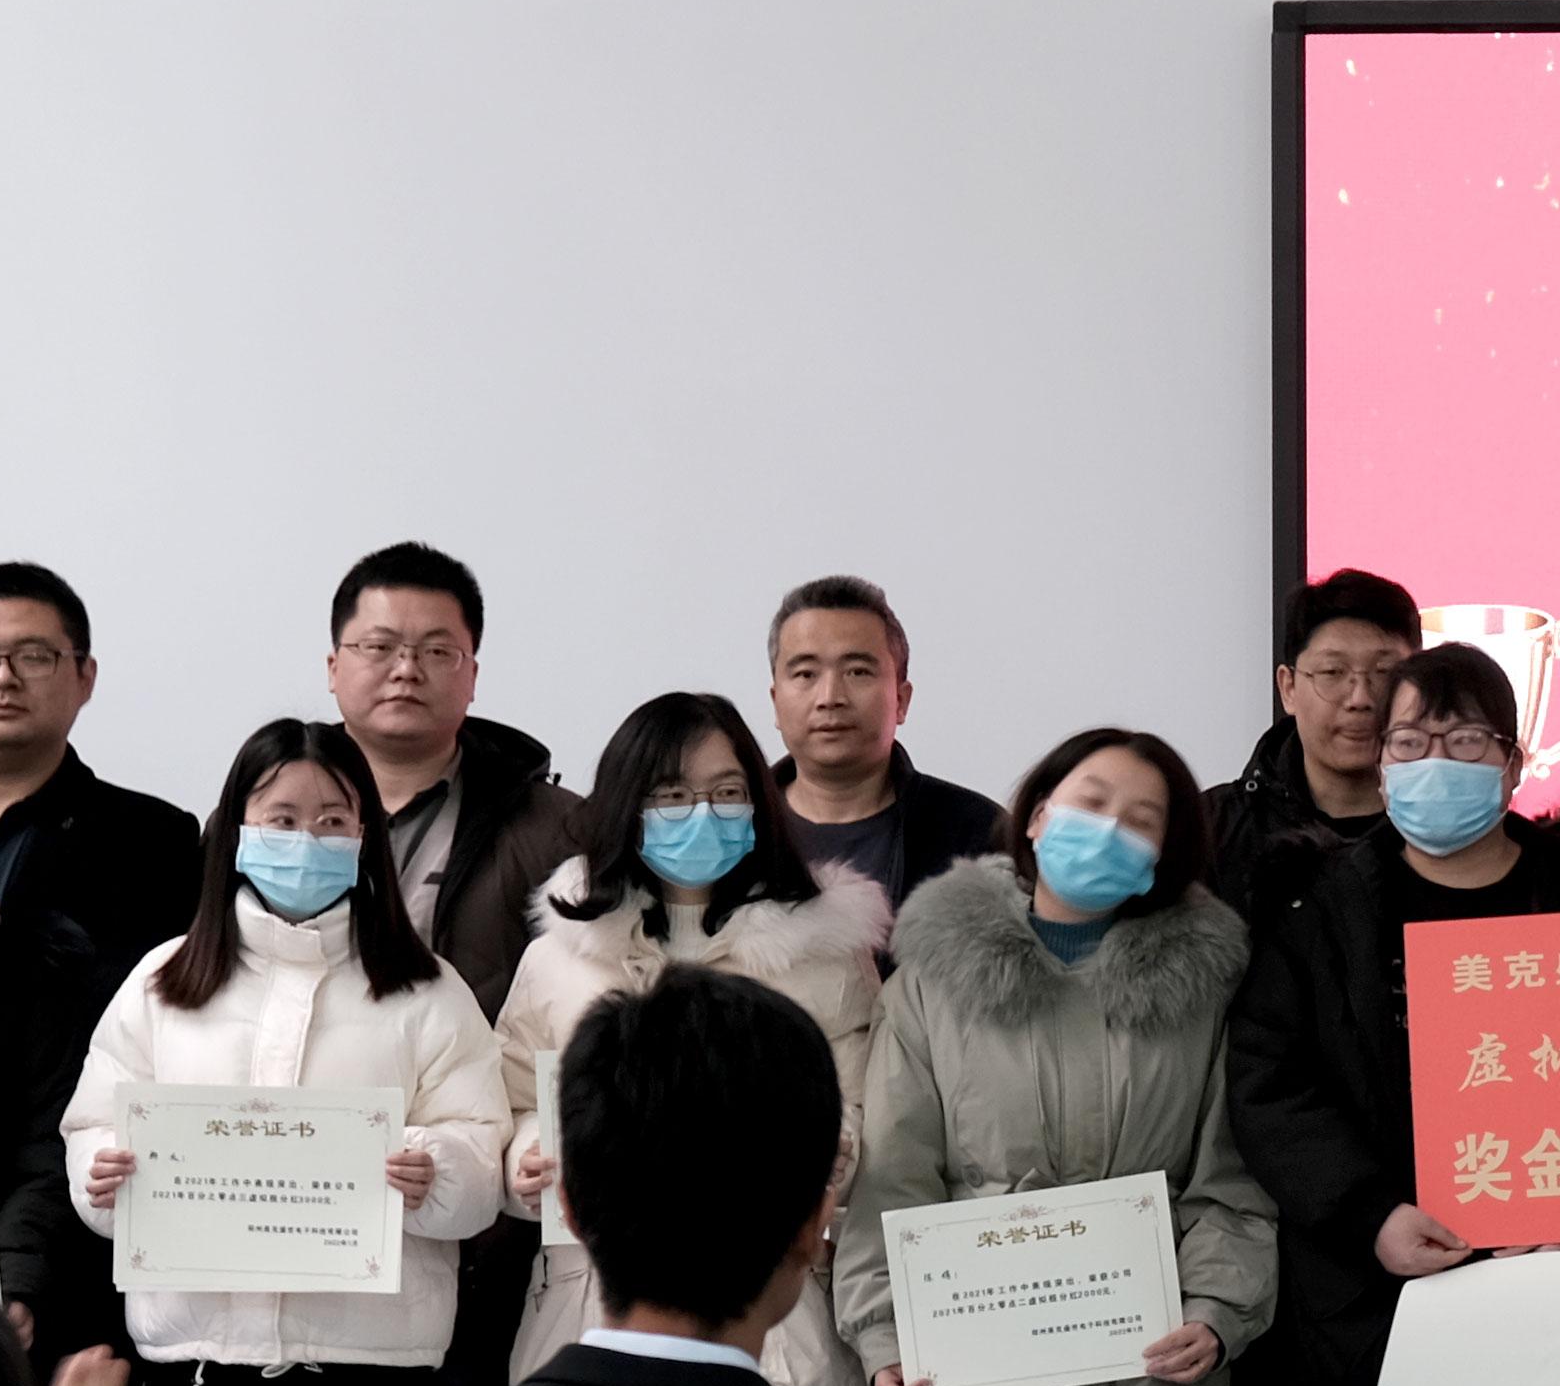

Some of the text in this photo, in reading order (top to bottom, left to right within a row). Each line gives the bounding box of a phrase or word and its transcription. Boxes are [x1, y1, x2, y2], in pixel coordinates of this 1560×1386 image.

[204, 1119, 316, 1138] 荣誉证书
[976, 1219, 1087, 1248] 荣誉证书
